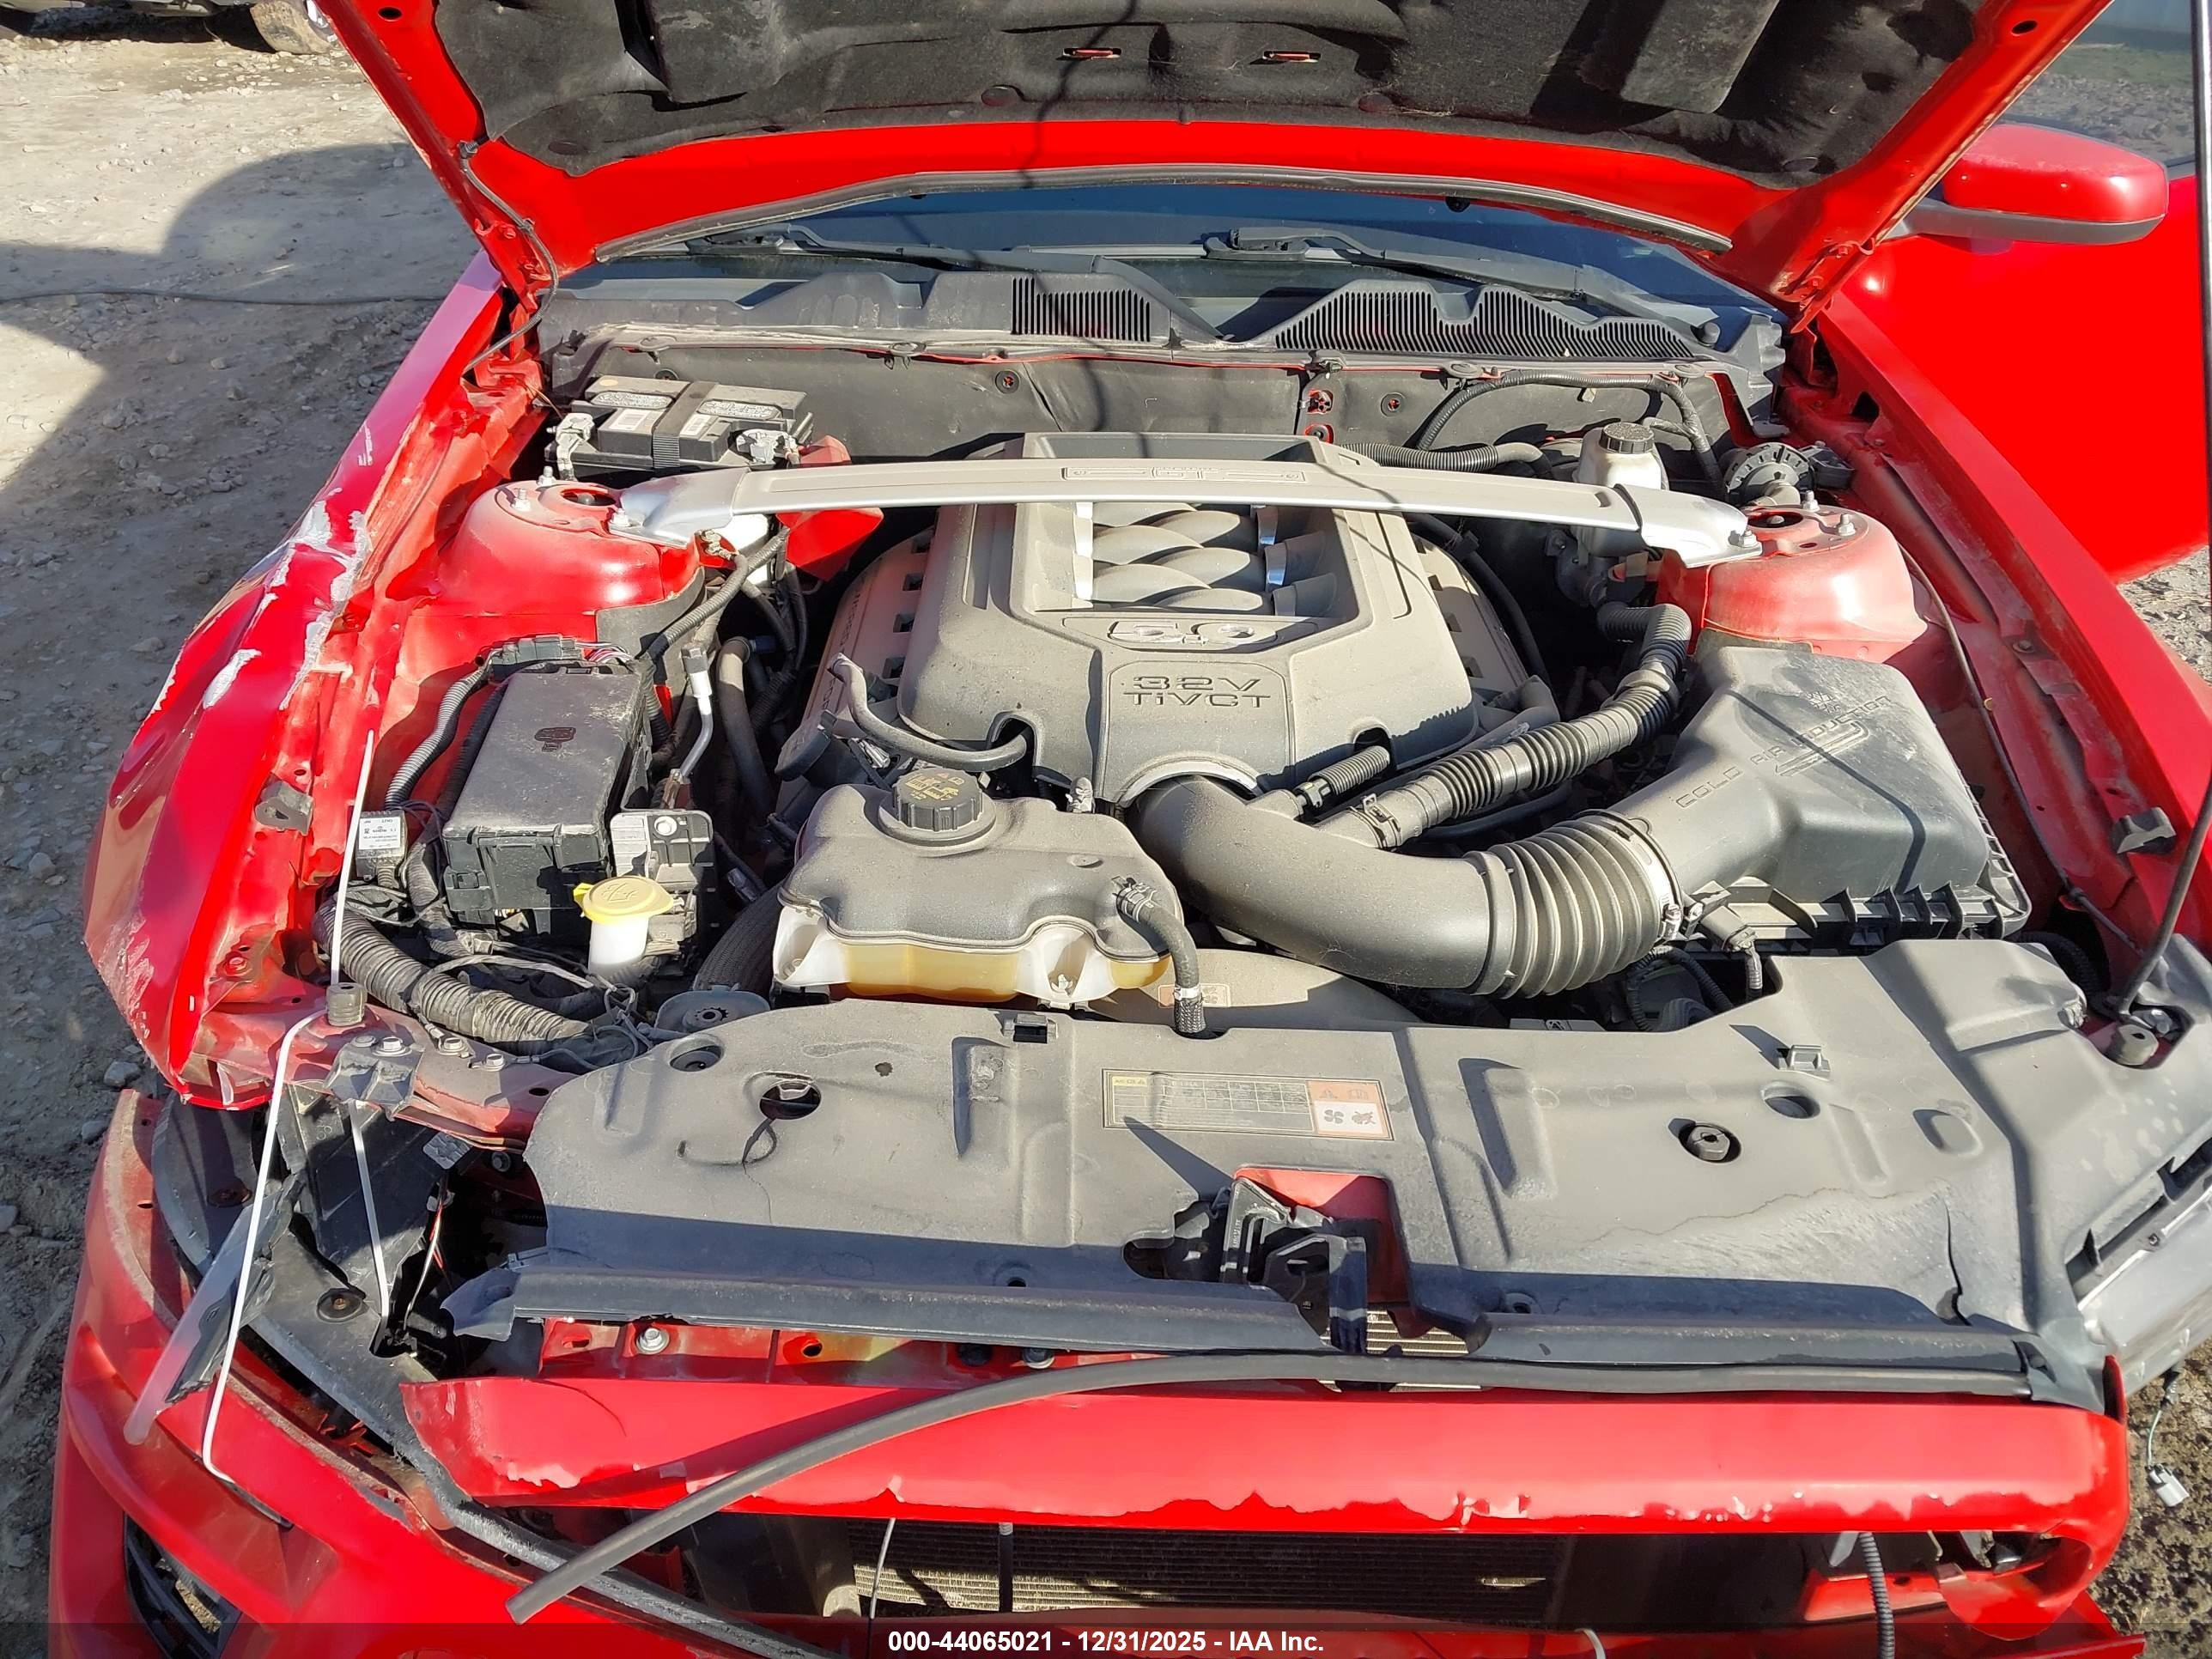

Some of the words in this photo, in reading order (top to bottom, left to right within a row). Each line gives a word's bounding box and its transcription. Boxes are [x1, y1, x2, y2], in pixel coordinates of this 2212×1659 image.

[1107, 620, 1278, 652] 5.0
[1133, 676, 1261, 692] 32V
[1675, 765, 1744, 809] COLD
